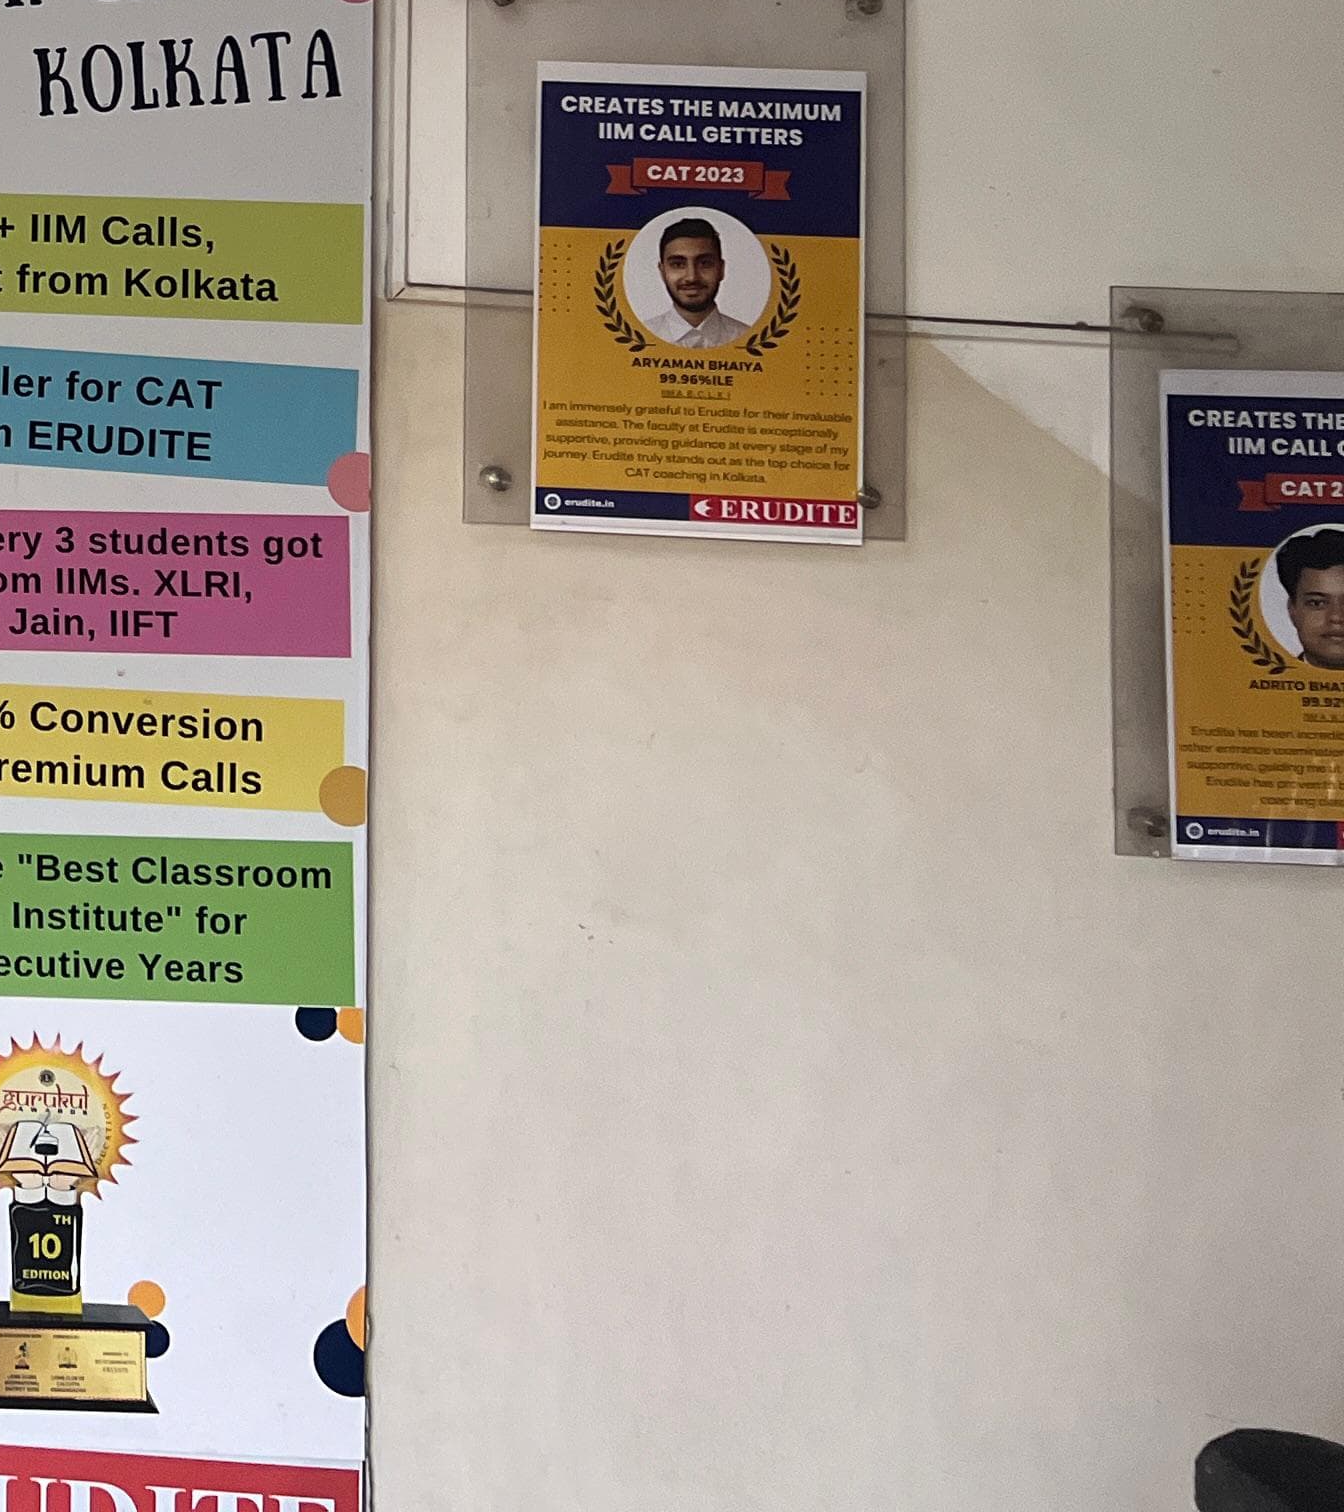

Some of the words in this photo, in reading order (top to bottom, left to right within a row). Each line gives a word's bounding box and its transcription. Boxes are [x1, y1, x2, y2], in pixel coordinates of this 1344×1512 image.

[34, 28, 342, 116] KOLKATA
[561, 96, 665, 116] CREATES
[670, 98, 713, 118] THE
[718, 101, 841, 122] MAXIMUM
[599, 122, 634, 141] IIM
[639, 124, 698, 143] CALL
[702, 126, 803, 146] GETTERS
[647, 165, 690, 181] CAT
[695, 167, 744, 183] 2023
[30, 214, 87, 243] IIM
[101, 215, 215, 252] Calls,
[16, 263, 108, 296] from
[124, 267, 278, 302] Kolkata
[632, 357, 705, 370] ARYAMAN
[708, 360, 763, 373] BHAIYA
[66, 369, 122, 402] for
[135, 376, 223, 410] CAT
[1189, 410, 1296, 428] CREATES
[1302, 412, 1344, 430] THE
[28, 421, 212, 462] ERUDITE
[1228, 438, 1265, 456] IIM
[1271, 438, 1332, 457] CALL
[1281, 480, 1327, 497] CAT
[721, 499, 856, 523] ERUDITE
[55, 526, 75, 554] 3
[88, 526, 250, 557] students
[263, 532, 323, 564] got
[56, 567, 140, 596] IIMs.
[154, 569, 252, 604] XLRI,
[8, 607, 96, 641] Jain,
[109, 609, 179, 639] IIFT
[1249, 680, 1305, 691] ADRITO
[29, 701, 265, 742] Conversion
[160, 761, 262, 795] Calls
[18, 853, 118, 883] "Best
[131, 856, 333, 889] Classroom
[12, 901, 182, 933] Institute"
[195, 905, 247, 935] for
[139, 953, 244, 984] Years
[0, 1084, 90, 1113] gurukul
[53, 1214, 71, 1225] TH
[28, 1233, 62, 1259] 10
[22, 1268, 69, 1281] EDITION
